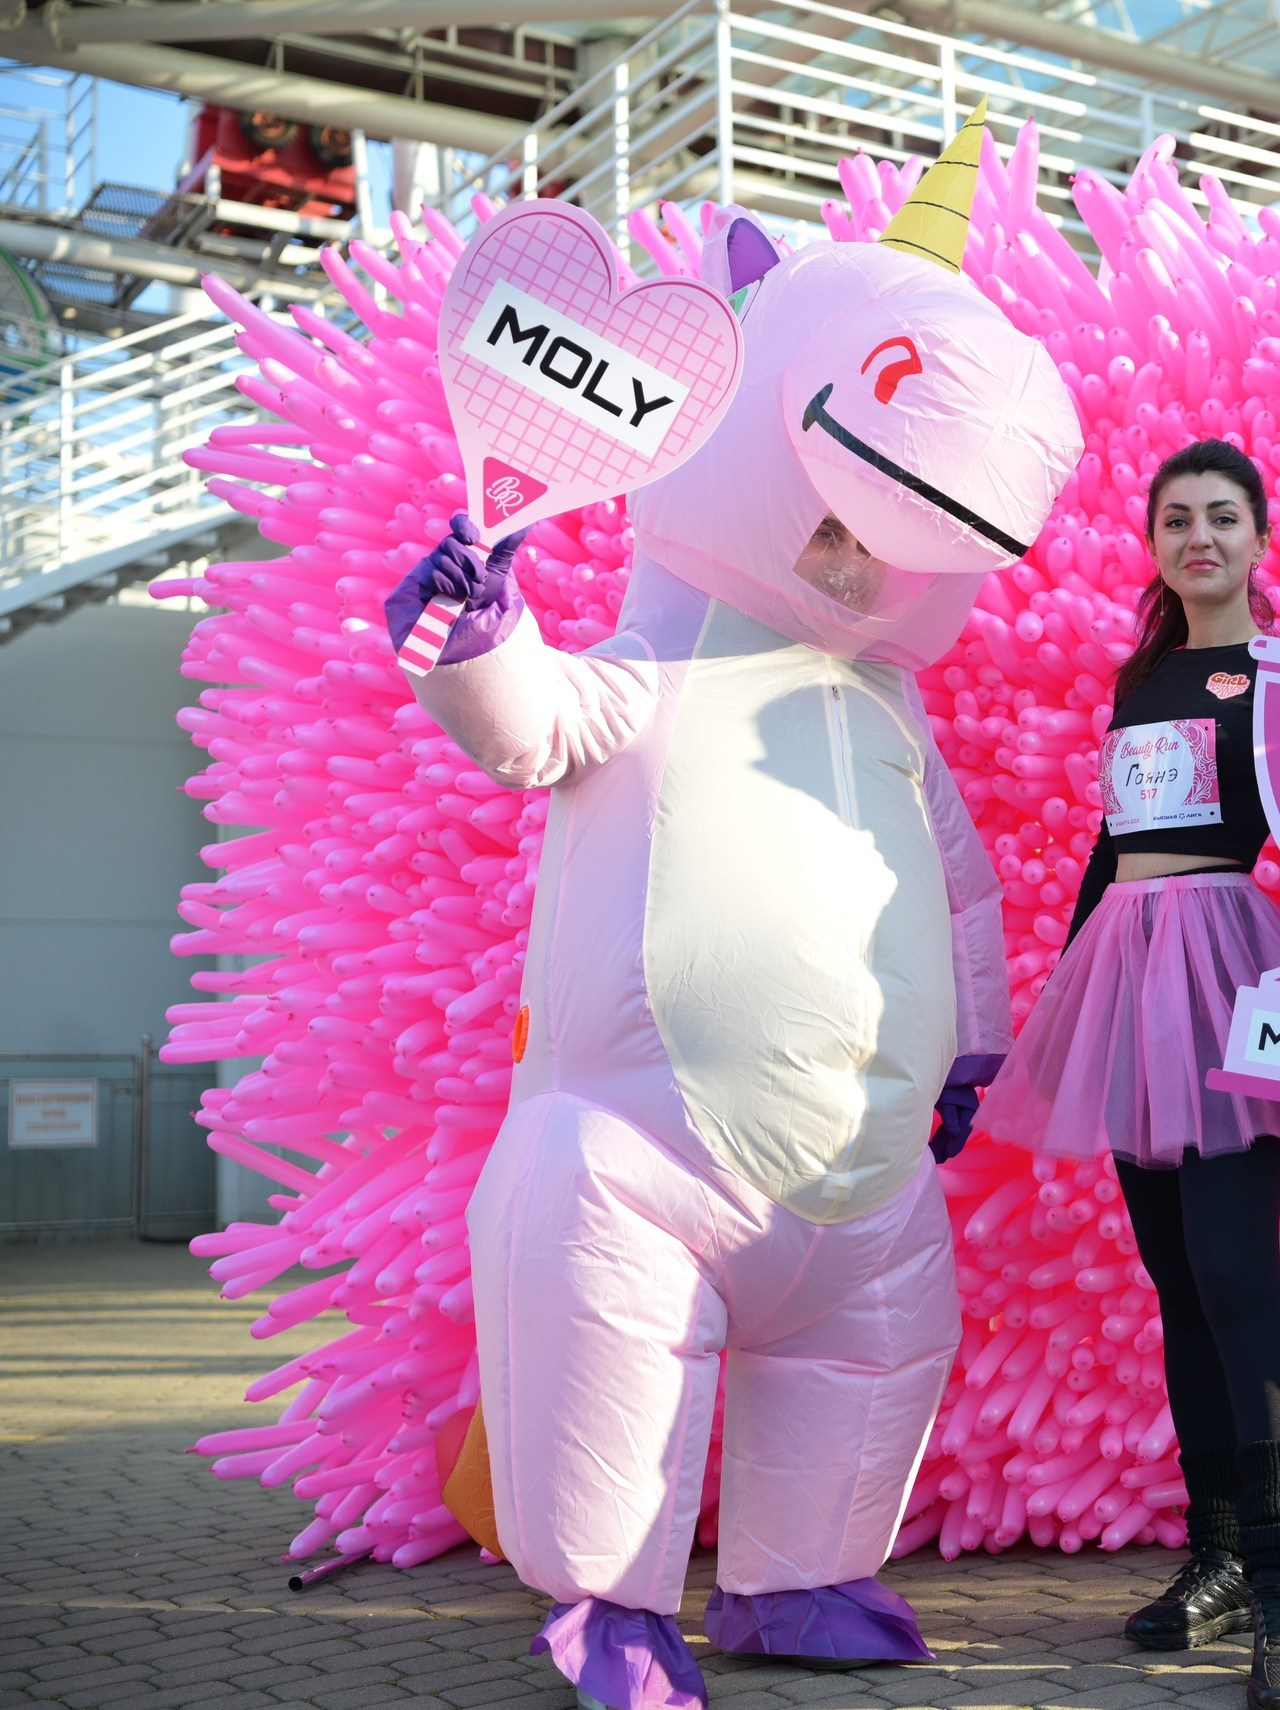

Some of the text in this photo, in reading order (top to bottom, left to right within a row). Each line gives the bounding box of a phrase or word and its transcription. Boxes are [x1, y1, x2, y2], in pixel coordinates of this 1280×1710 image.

[486, 304, 674, 428] MOLY
[1120, 736, 1180, 760] Beauty Run
[1140, 788, 1158, 800] 517
